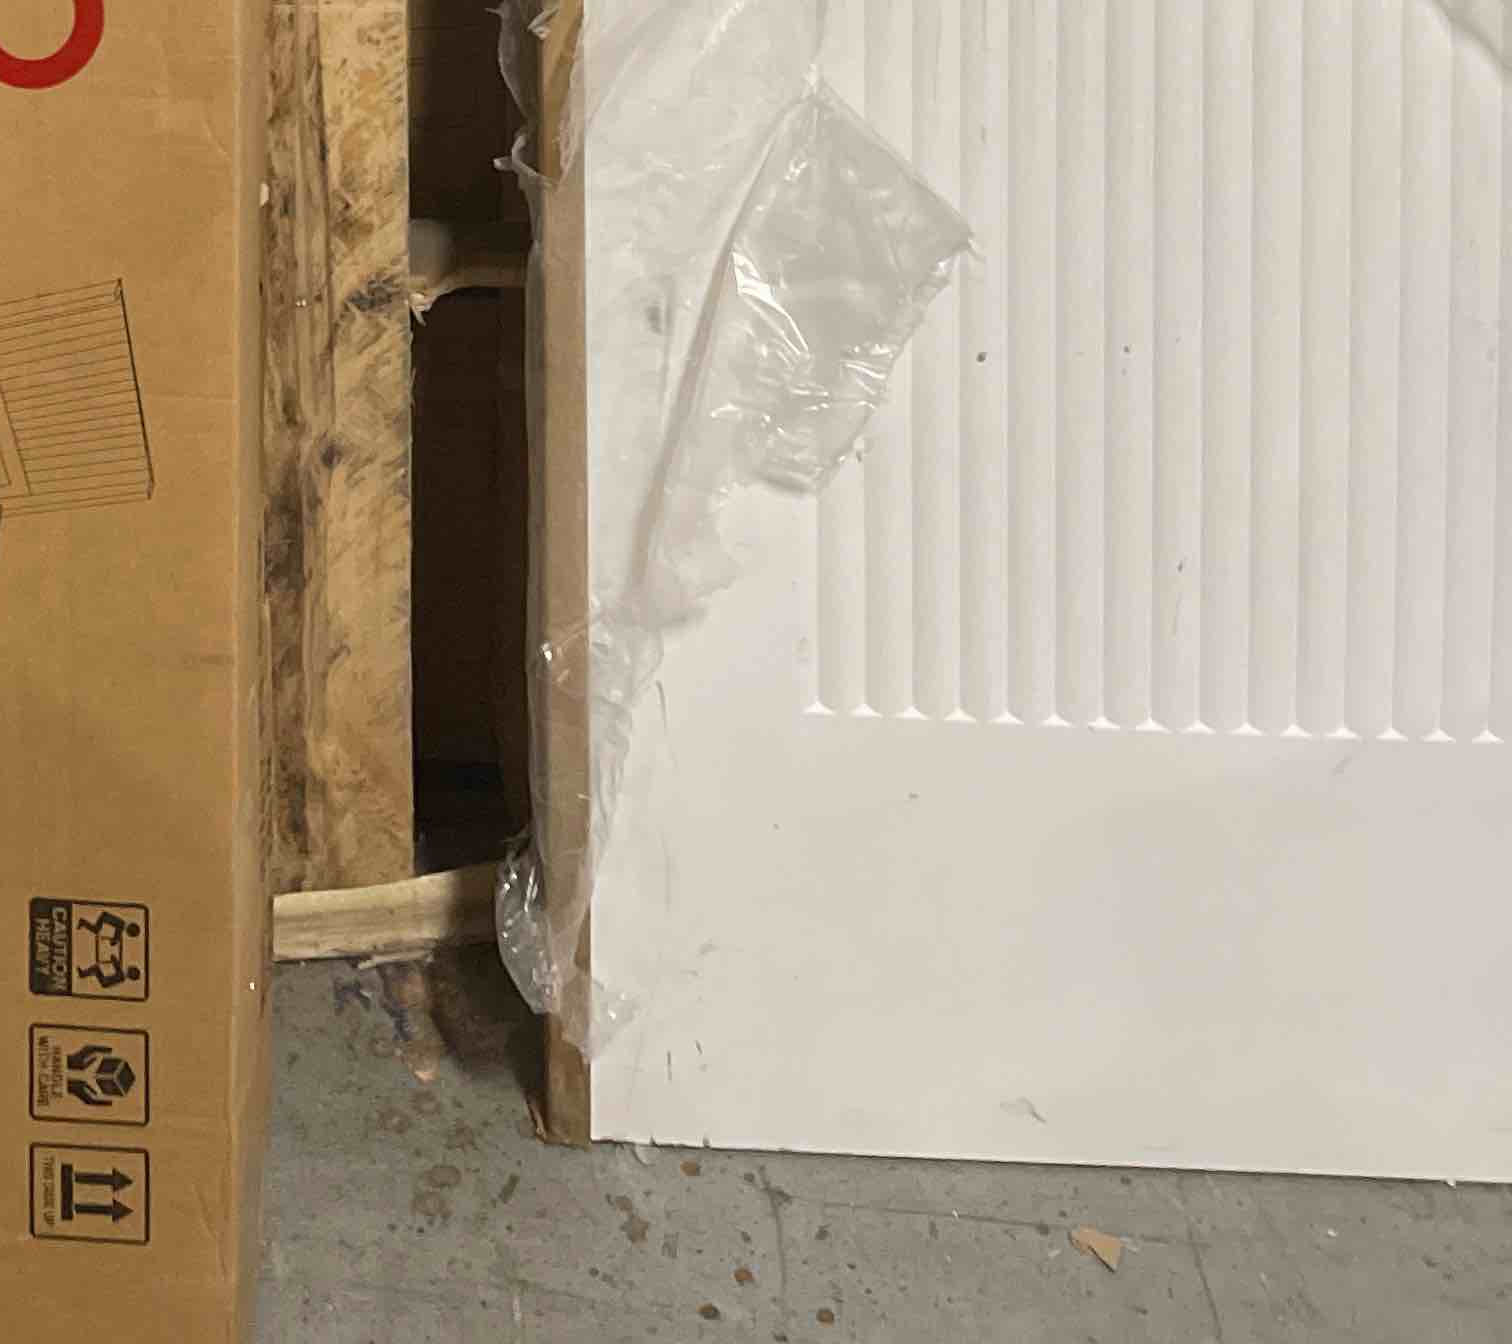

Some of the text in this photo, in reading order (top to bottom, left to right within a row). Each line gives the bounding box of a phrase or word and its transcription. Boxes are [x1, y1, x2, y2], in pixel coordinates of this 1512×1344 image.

[34, 914, 50, 977] HEAVY
[51, 905, 68, 992] CAUTION
[50, 1044, 62, 1100] HANDLE
